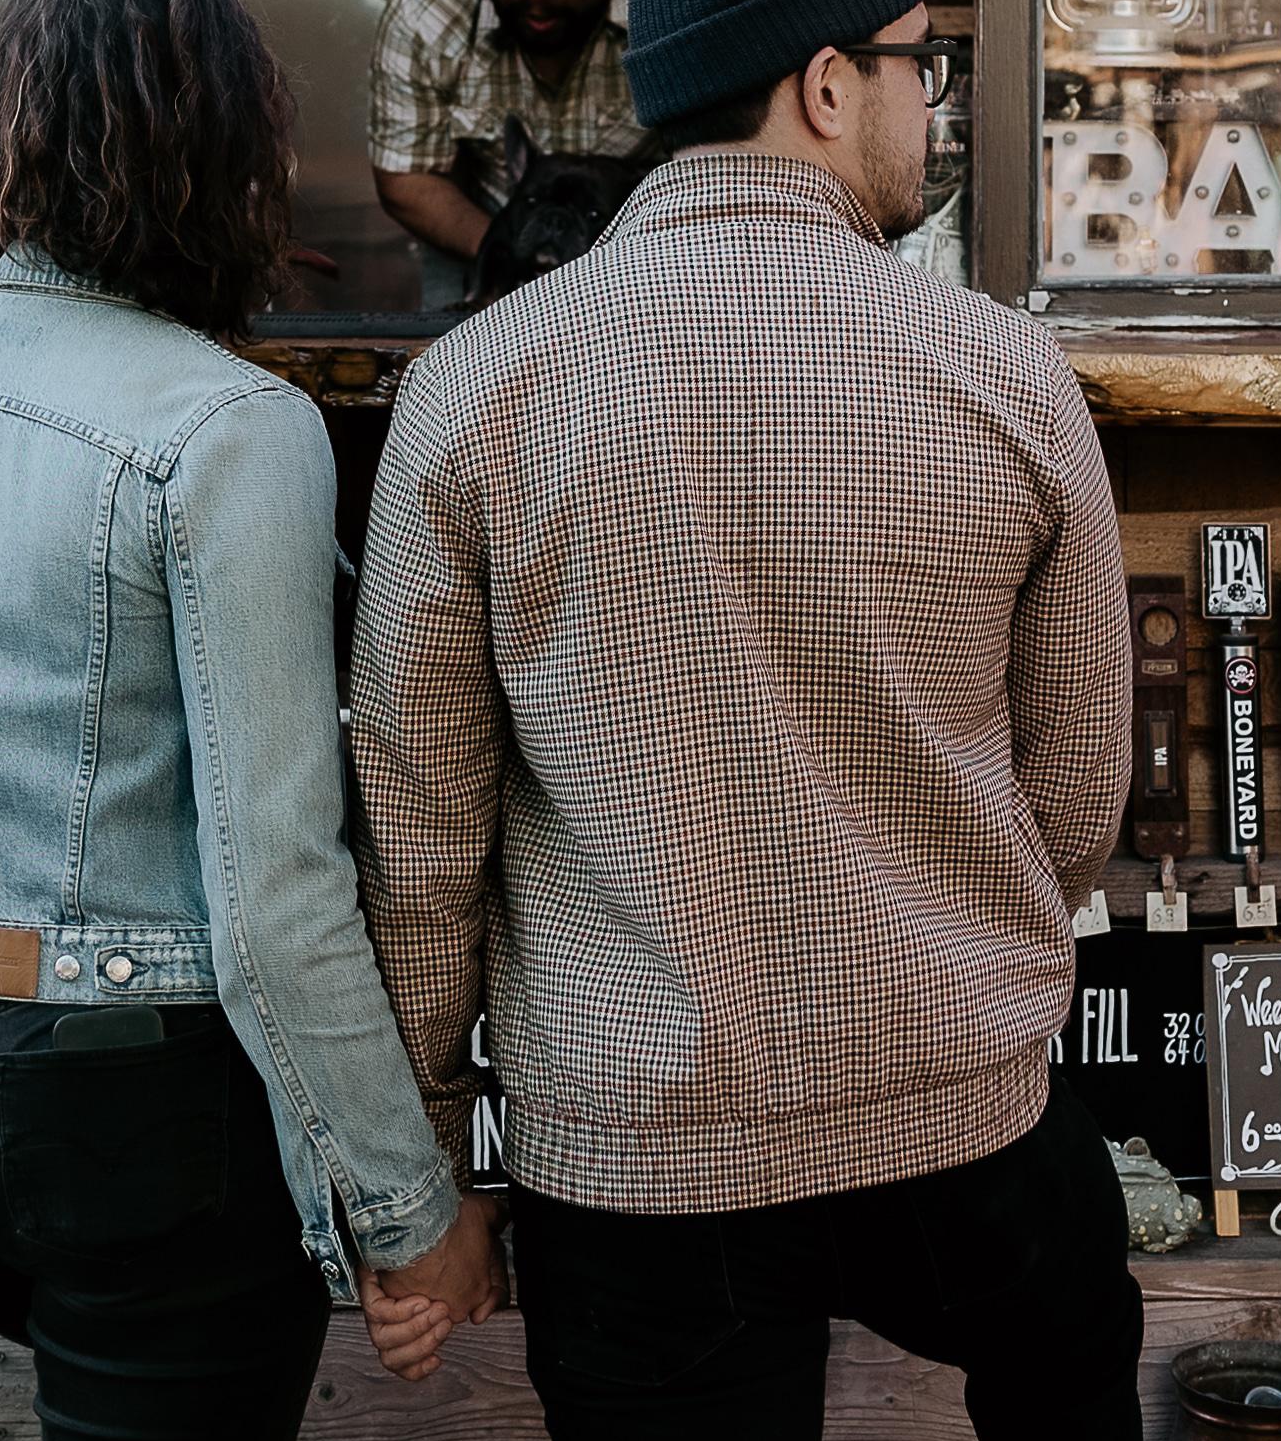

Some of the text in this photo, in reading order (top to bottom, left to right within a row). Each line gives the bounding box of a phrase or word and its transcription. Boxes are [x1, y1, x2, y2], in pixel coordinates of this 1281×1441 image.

[1211, 540, 1263, 591] IPA
[1155, 746, 1167, 766] IPA
[1234, 700, 1258, 839] BONEYARD
[1082, 988, 1138, 1064] FILL
[1163, 1012, 1190, 1038] 32
[1164, 1038, 1189, 1065] 64
